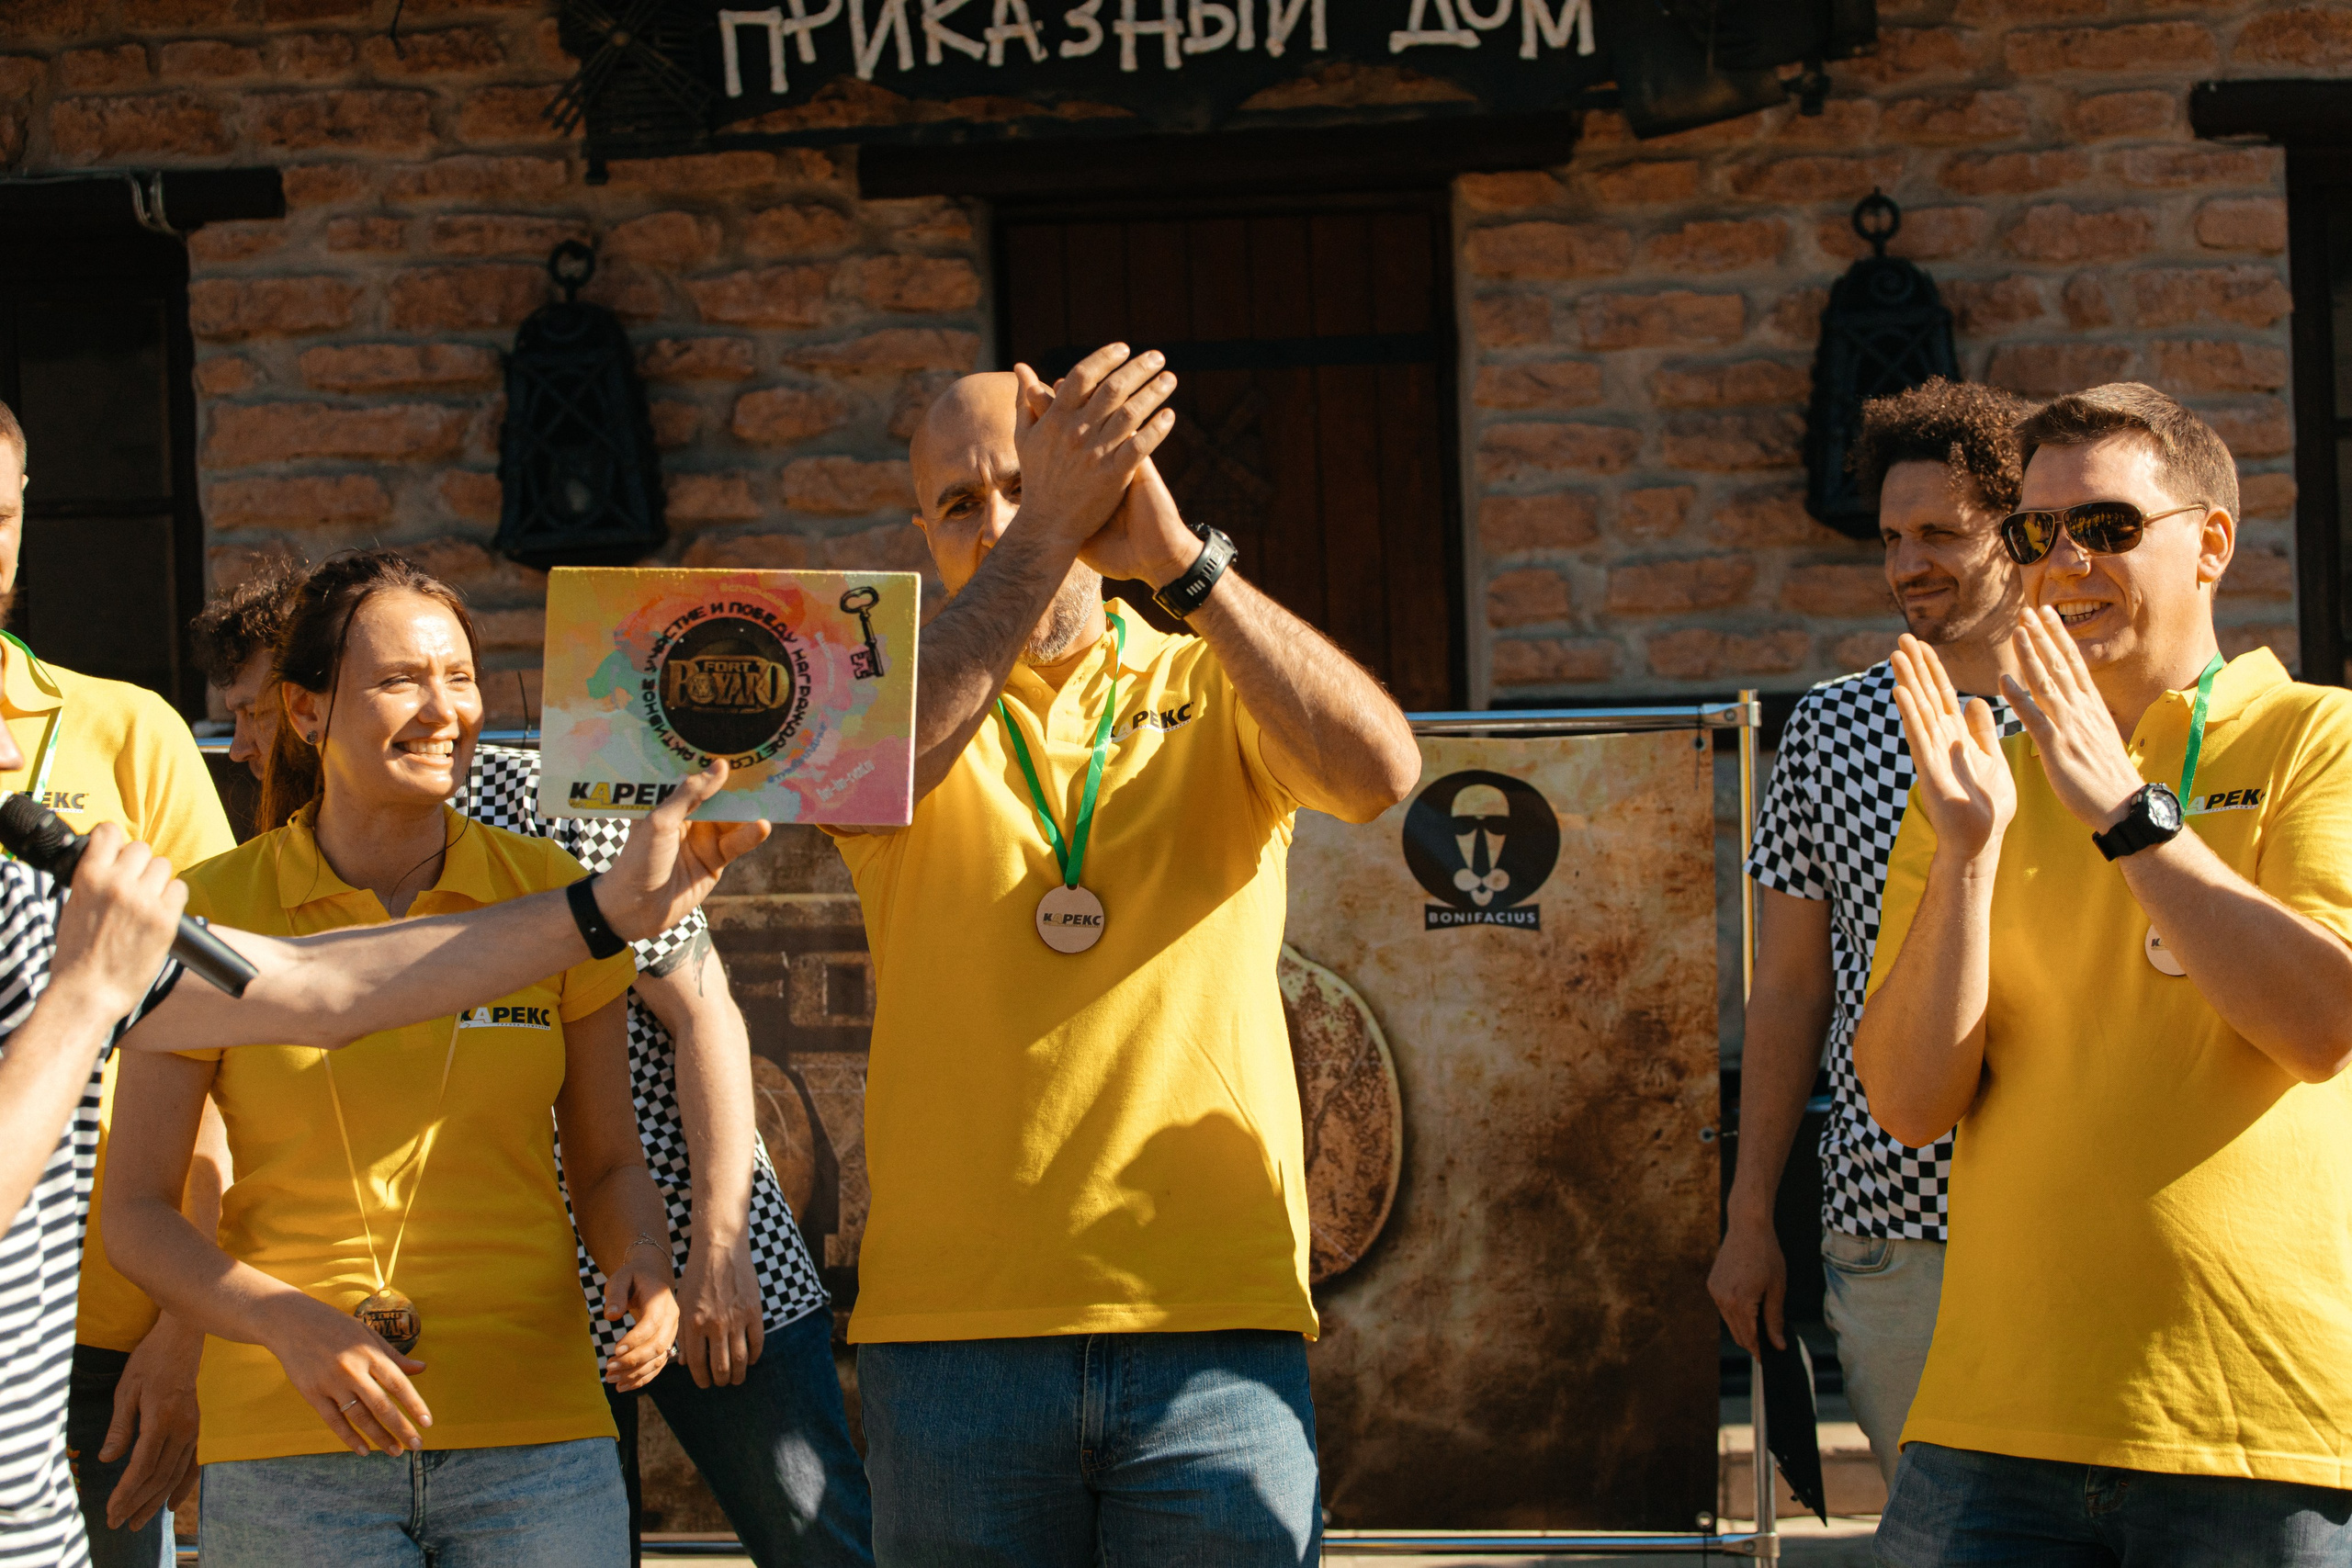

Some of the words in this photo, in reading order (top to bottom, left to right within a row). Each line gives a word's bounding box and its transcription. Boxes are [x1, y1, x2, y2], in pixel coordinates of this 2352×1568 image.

[710, 602, 724, 615] И
[729, 602, 797, 643] ПОБЕДУ
[644, 605, 707, 672] УЧАСТИЕ
[704, 661, 752, 671] FORT
[729, 649, 811, 770] НАГРАЖДАЕТСЯ
[570, 782, 678, 805] КАРЕК
[1043, 913, 1102, 926] КАРЕКС
[1429, 911, 1535, 923] BONIFACIUS
